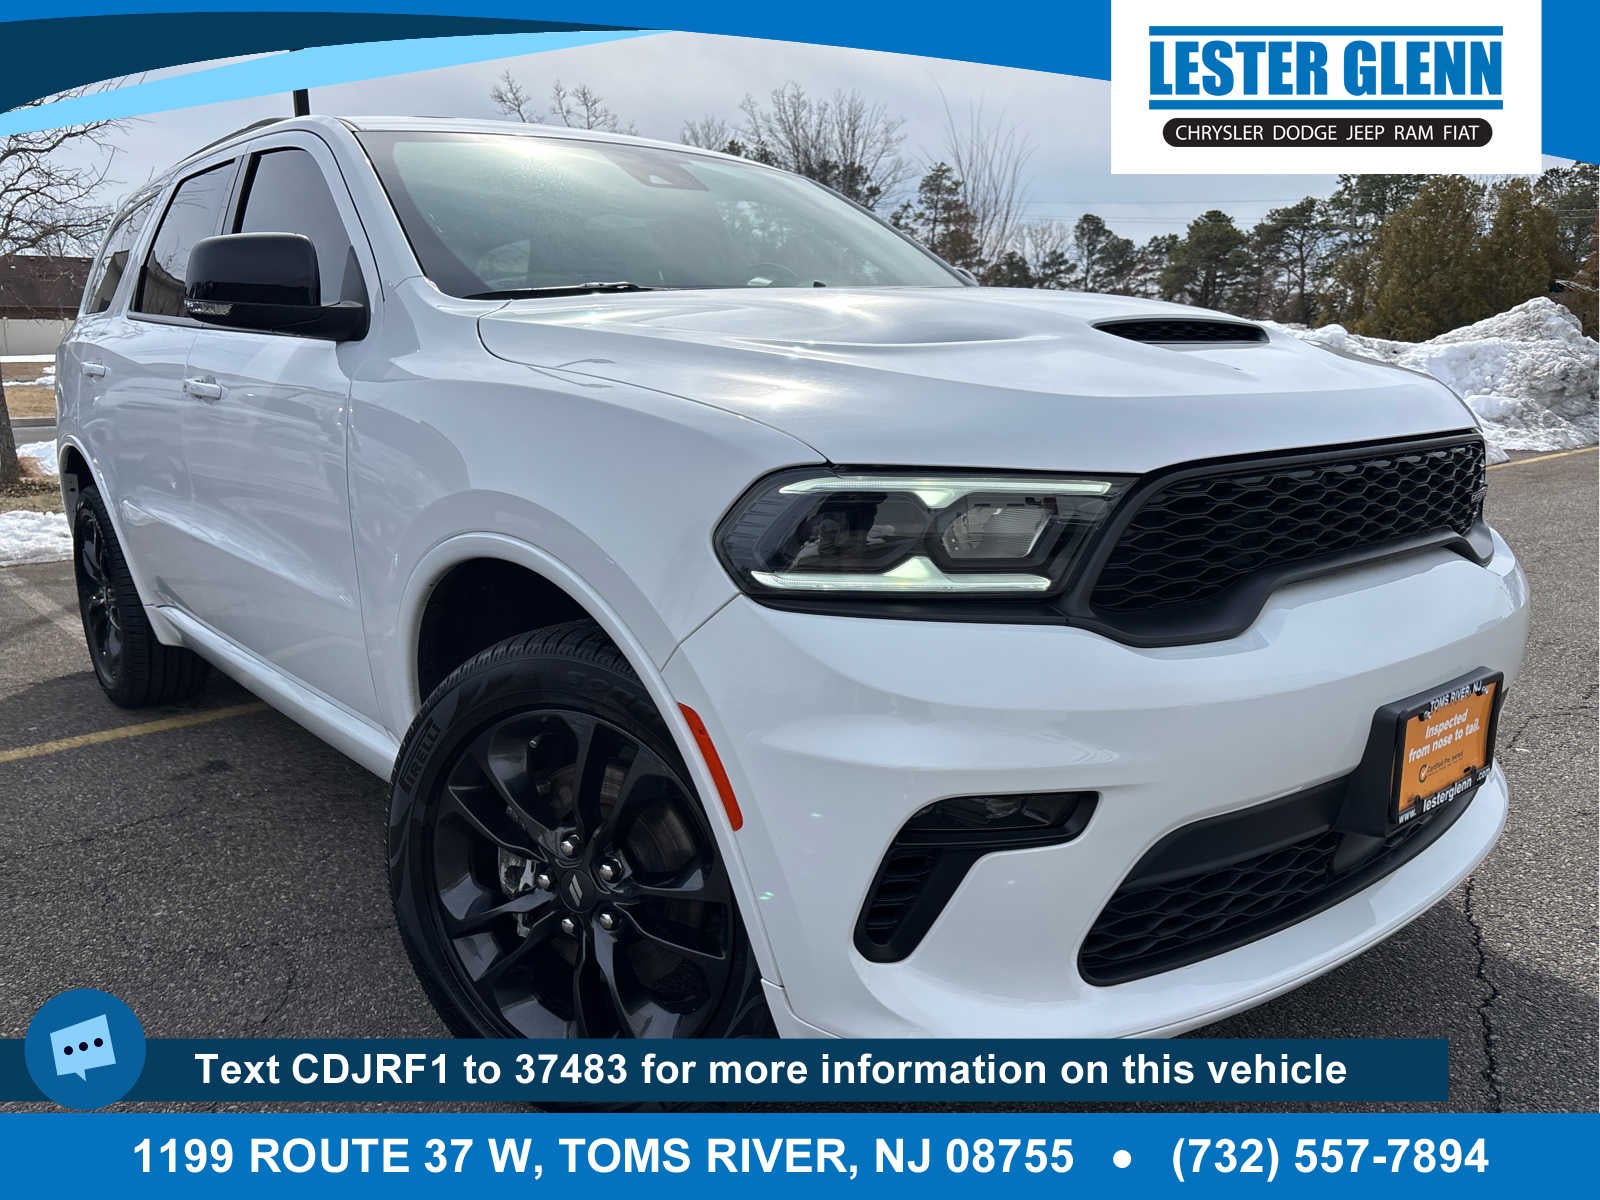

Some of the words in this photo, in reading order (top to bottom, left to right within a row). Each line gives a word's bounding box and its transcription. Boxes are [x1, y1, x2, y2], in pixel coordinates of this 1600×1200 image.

[1430, 695, 1449, 712] TOMS
[1472, 680, 1483, 694] NJ
[1425, 709, 1468, 739] Inspected
[399, 721, 443, 793] PIRELLI
[1408, 744, 1431, 764] from
[1432, 733, 1453, 752] nose
[1454, 727, 1464, 742] to
[1423, 777, 1472, 813] lesterglenn
